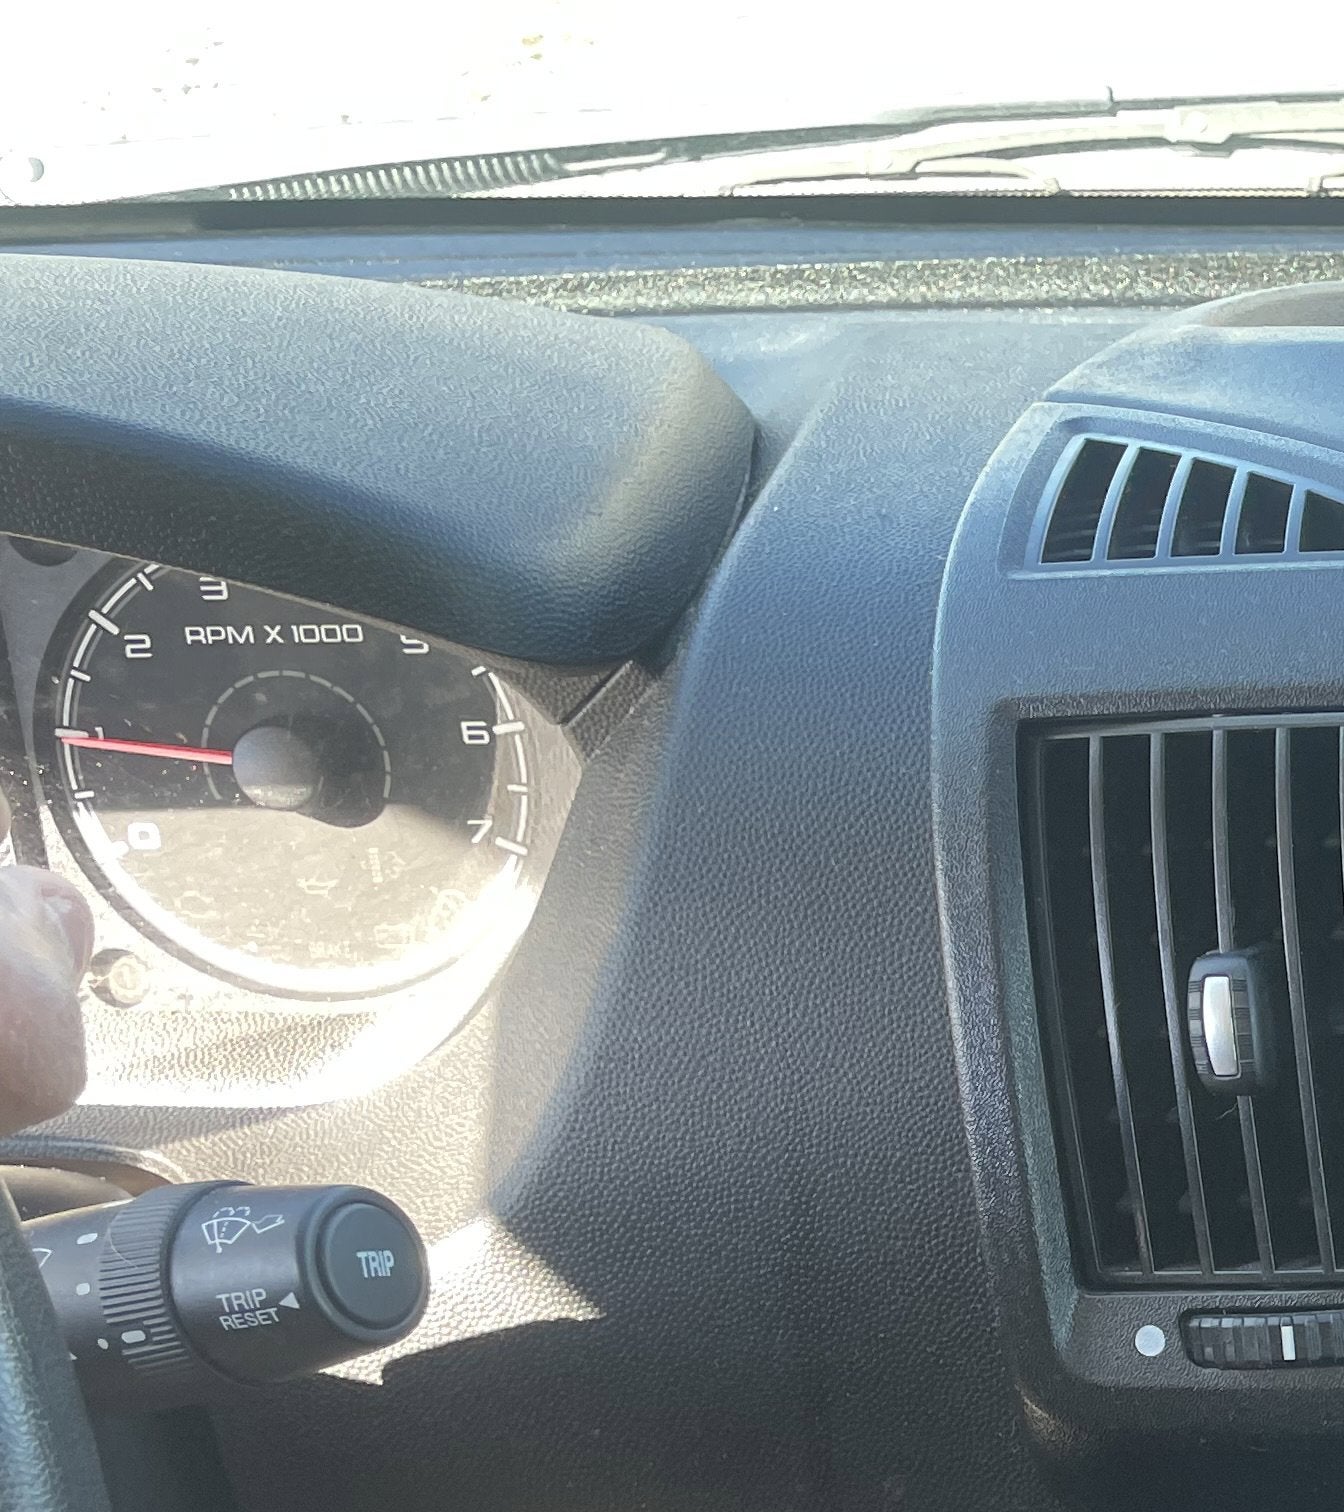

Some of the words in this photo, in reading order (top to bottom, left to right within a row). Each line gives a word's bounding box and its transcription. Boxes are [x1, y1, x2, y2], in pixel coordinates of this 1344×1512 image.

[123, 634, 153, 658] 2
[184, 625, 255, 645] RPM
[263, 625, 284, 644] X
[290, 624, 364, 643] 1000
[460, 721, 490, 745] 6
[467, 818, 493, 844] 7
[356, 1250, 395, 1278] TRIP
[215, 1287, 267, 1313] TRIP
[218, 1307, 280, 1331] RESET
